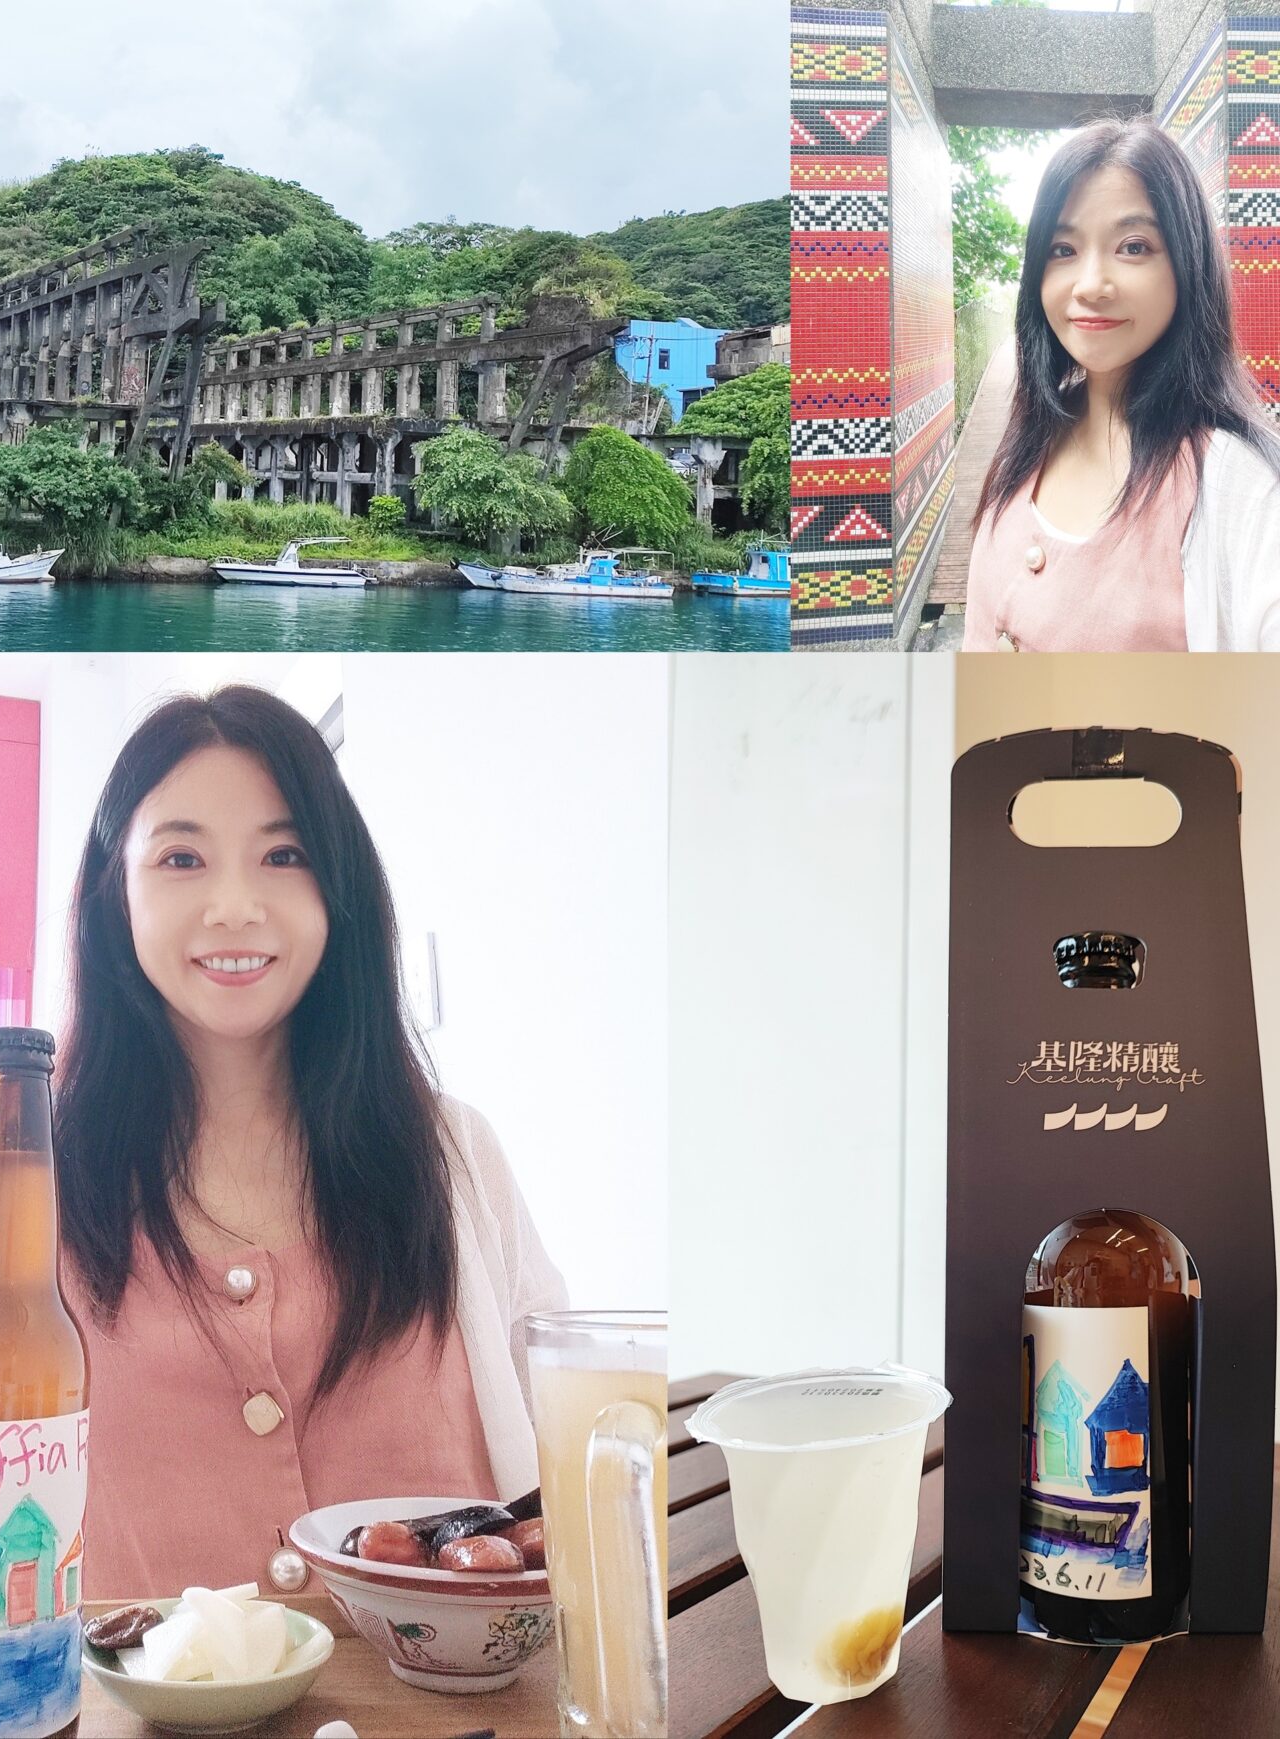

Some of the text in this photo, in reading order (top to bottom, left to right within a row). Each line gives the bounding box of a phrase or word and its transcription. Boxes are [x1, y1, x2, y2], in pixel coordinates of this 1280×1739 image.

[1032, 1040, 1181, 1074] 基隆精釀
[1006, 1062, 1206, 1092] Keelung Craft
